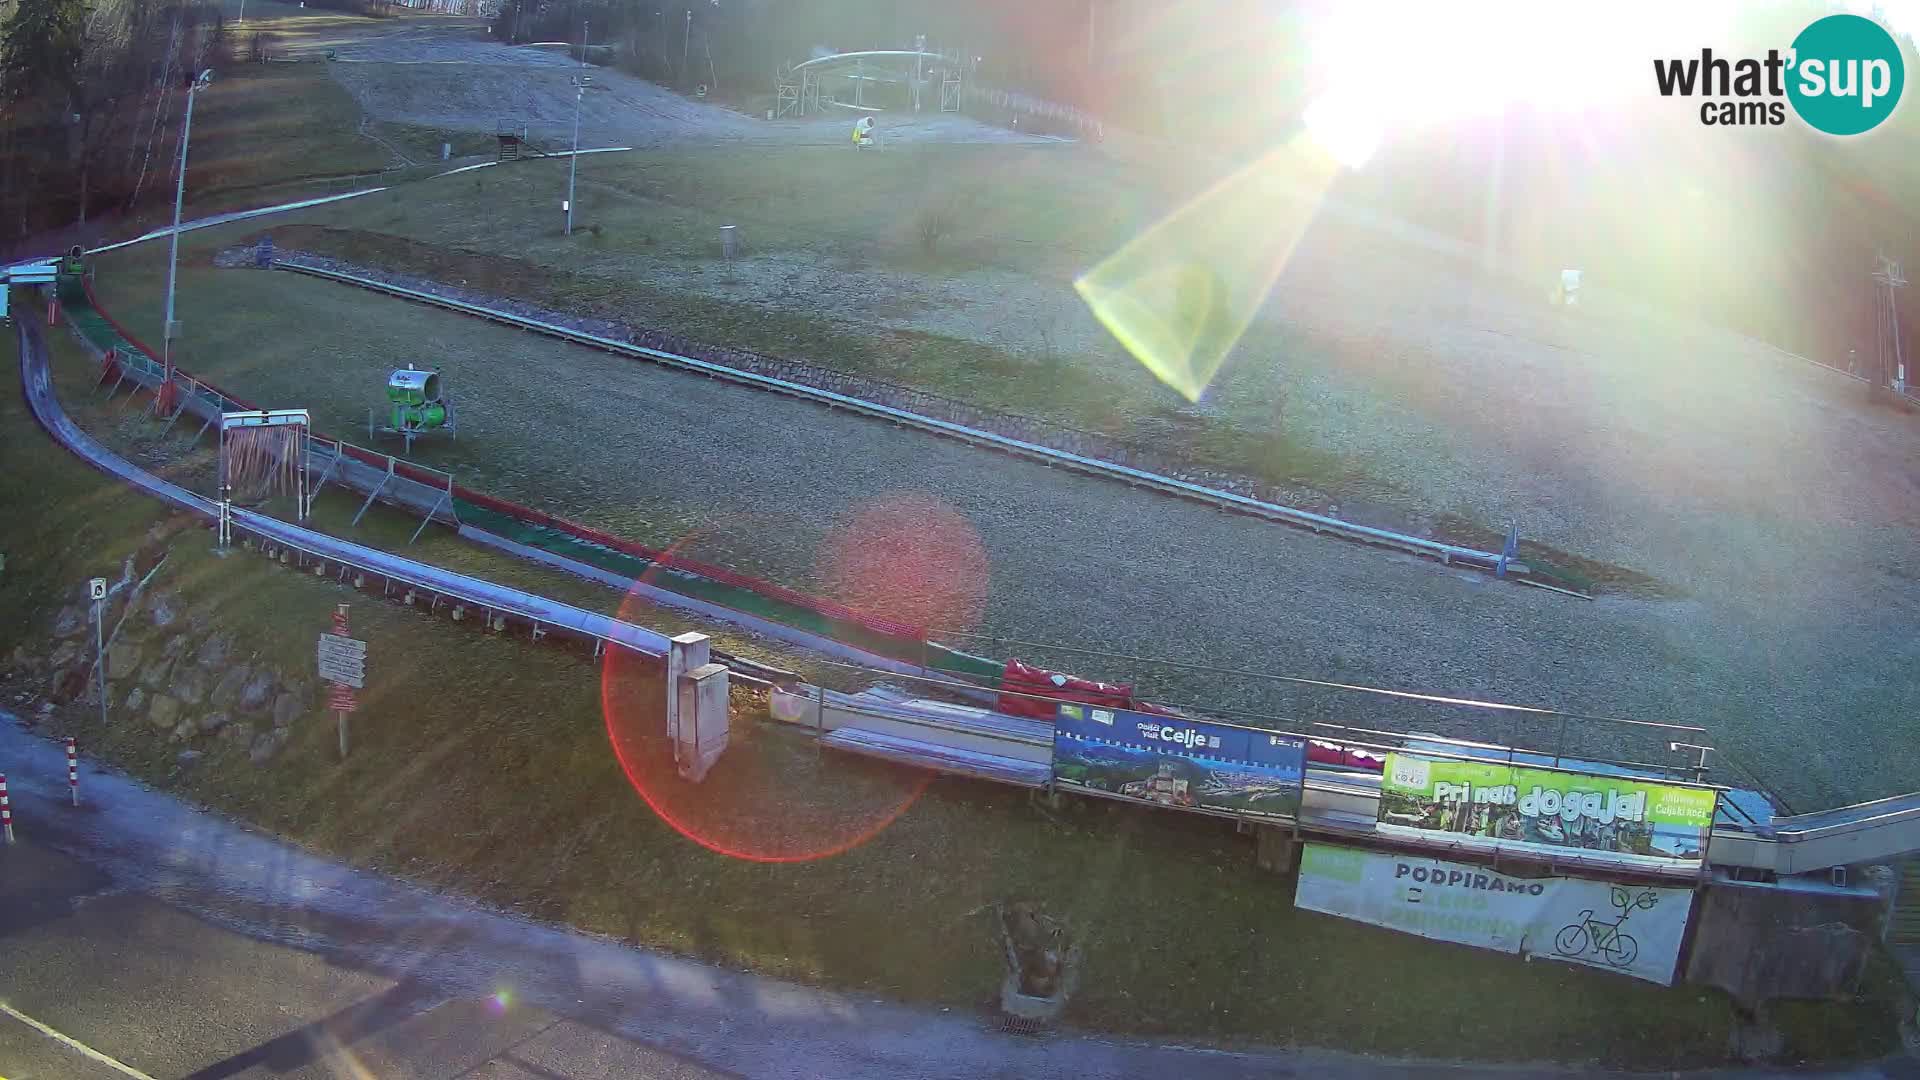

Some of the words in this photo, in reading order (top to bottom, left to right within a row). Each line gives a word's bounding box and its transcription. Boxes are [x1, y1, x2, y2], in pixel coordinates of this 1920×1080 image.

[1160, 726, 1206, 749] Celje
[1433, 781, 1470, 803] Pri
[1474, 784, 1517, 805] nas
[1395, 863, 1545, 896] PODPIRAMO
